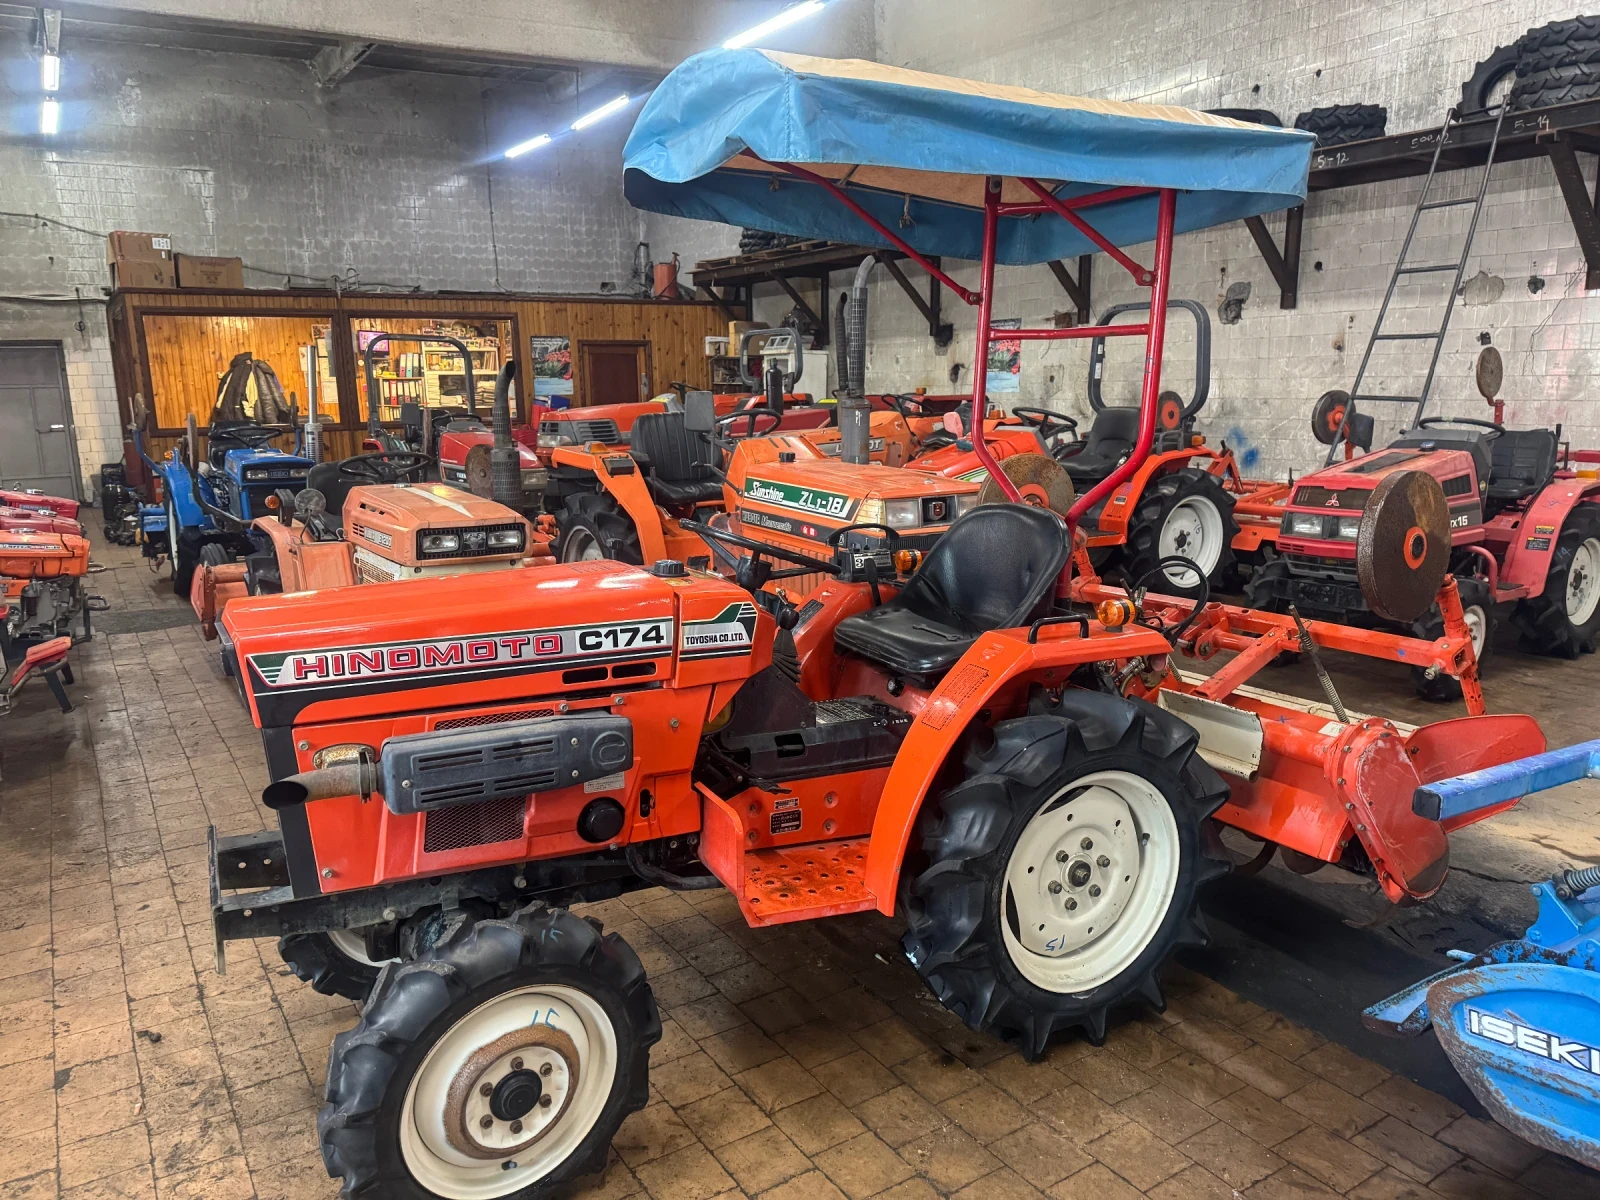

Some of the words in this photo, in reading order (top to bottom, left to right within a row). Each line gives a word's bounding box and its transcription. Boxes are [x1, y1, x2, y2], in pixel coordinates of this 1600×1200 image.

[750, 482, 785, 502] Sunshine
[292, 633, 563, 680] HINOMOTO
[577, 624, 665, 651] C174
[685, 635, 717, 645] TOYOSHA
[1468, 1008, 1600, 1076] ISEKI
